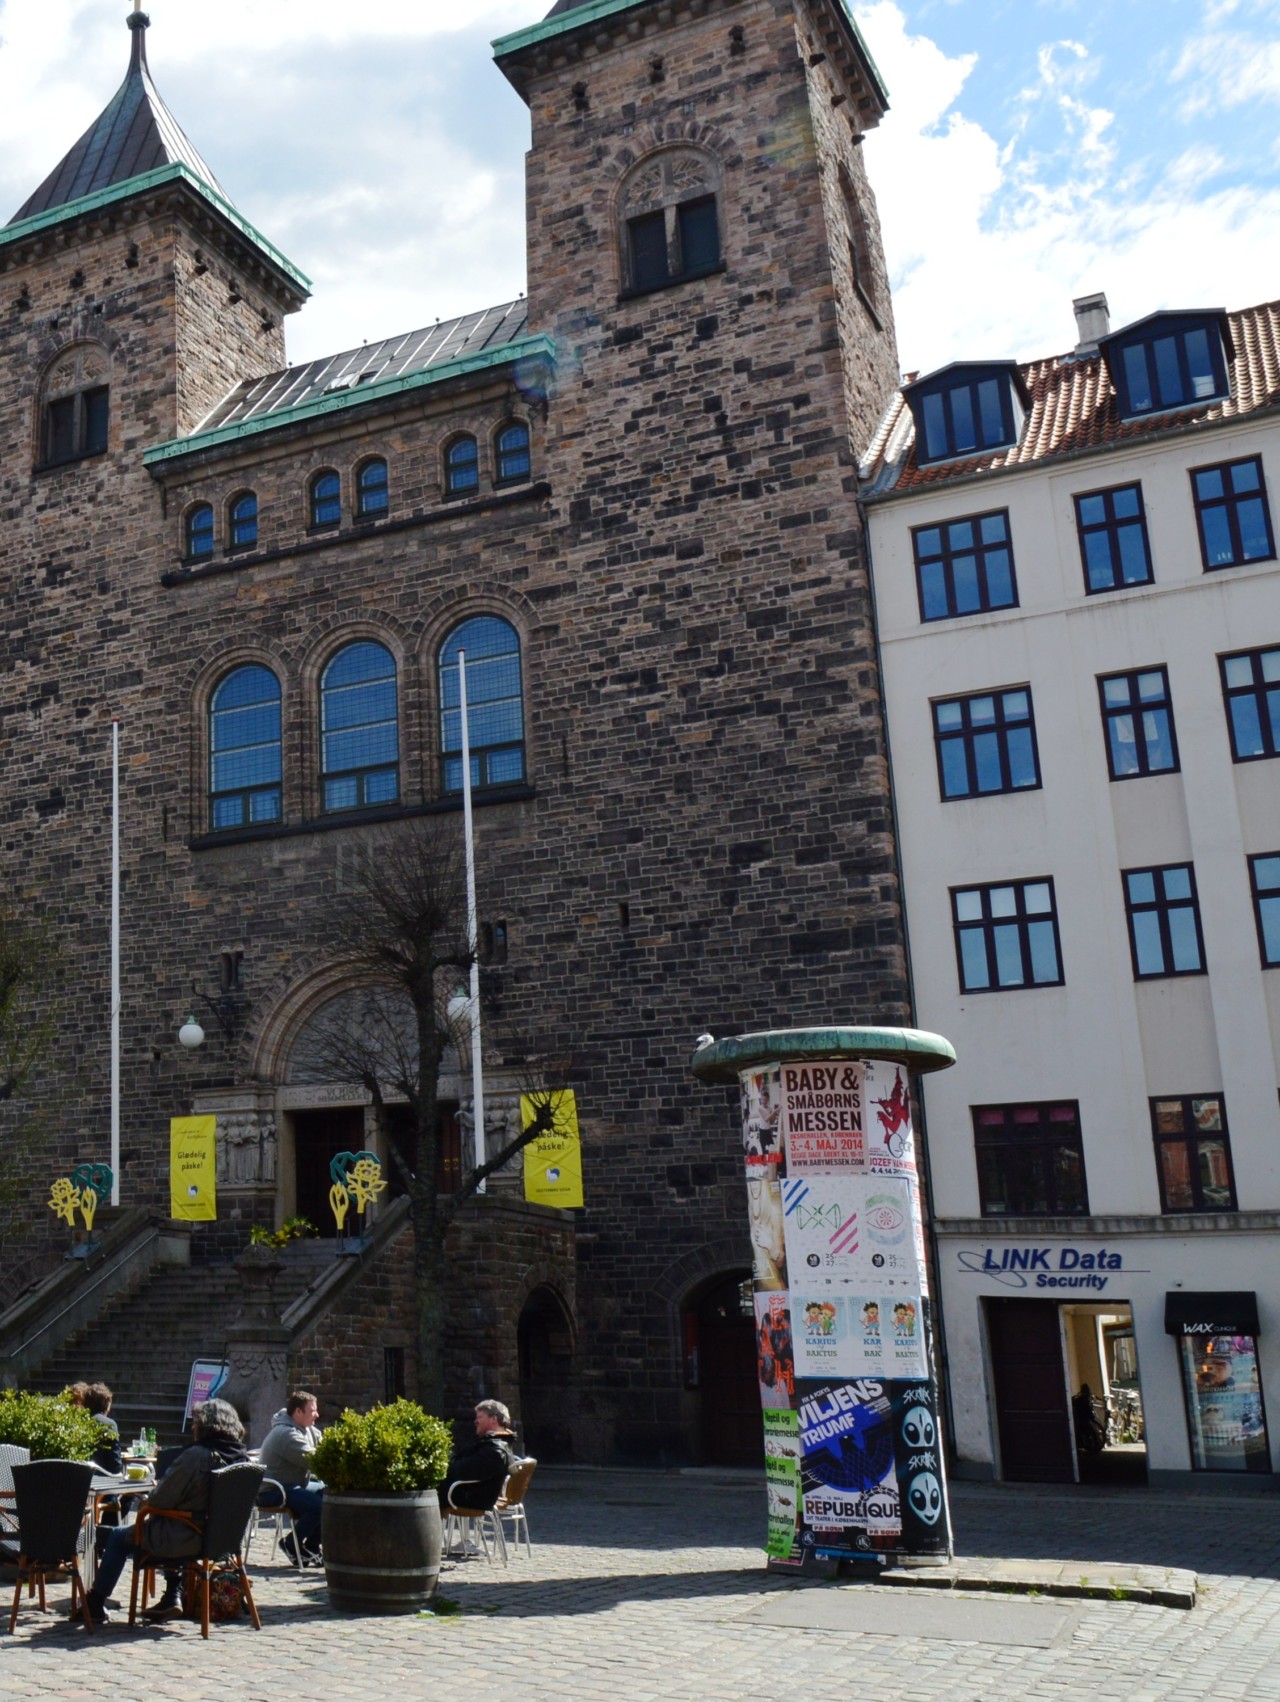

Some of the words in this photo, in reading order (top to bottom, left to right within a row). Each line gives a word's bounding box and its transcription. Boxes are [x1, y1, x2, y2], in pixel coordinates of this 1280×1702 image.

[785, 1067, 838, 1092] BABY
[841, 1067, 859, 1091] &
[787, 1092, 861, 1110] SMÅBØRNS
[789, 1111, 862, 1132] MESSEN
[537, 1142, 565, 1152] påske!
[816, 1139, 838, 1150] MAJ
[841, 1139, 863, 1150] 2014
[177, 1151, 207, 1160] Glædelig
[792, 1158, 865, 1167] WWW.BABYMESSEN.COM
[181, 1161, 203, 1172] påske!
[983, 1249, 1051, 1270] LINK
[1059, 1249, 1123, 1270] Data
[1036, 1273, 1108, 1291] Security
[1183, 1323, 1215, 1333] WAX
[797, 1379, 883, 1430] VILJENS
[781, 1416, 790, 1425] og
[800, 1412, 855, 1447] TRIUMF
[778, 1464, 786, 1474] og
[805, 1500, 902, 1518] REPUBLIQUE
